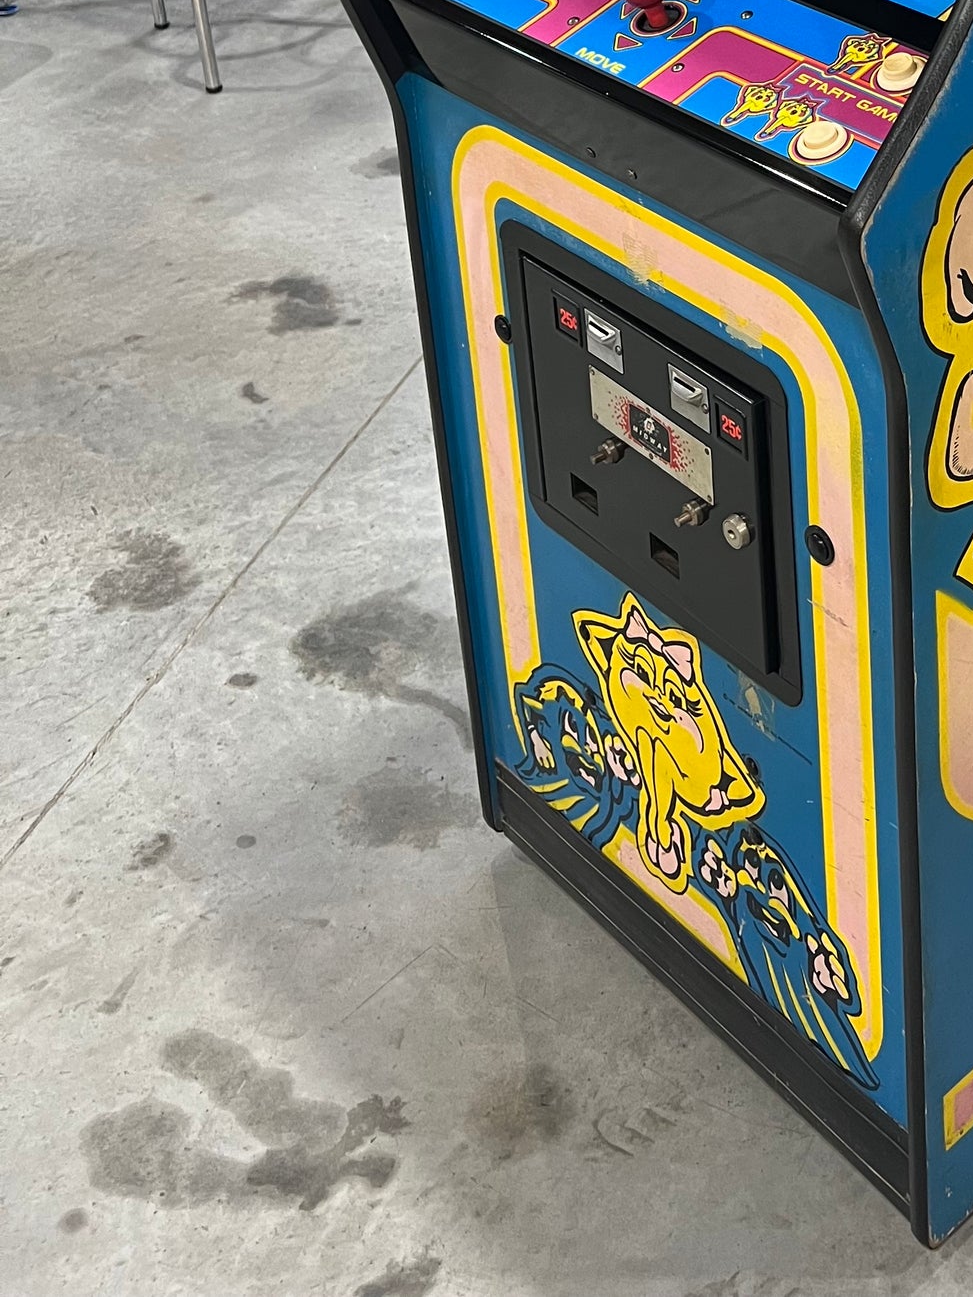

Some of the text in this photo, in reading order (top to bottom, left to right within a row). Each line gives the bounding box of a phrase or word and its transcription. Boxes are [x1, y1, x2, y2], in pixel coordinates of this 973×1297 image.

[575, 46, 627, 75] MOVE
[794, 73, 857, 102] START
[559, 307, 578, 331] 25¢
[632, 424, 668, 454] MIDWAY
[721, 414, 743, 441] 25¢
